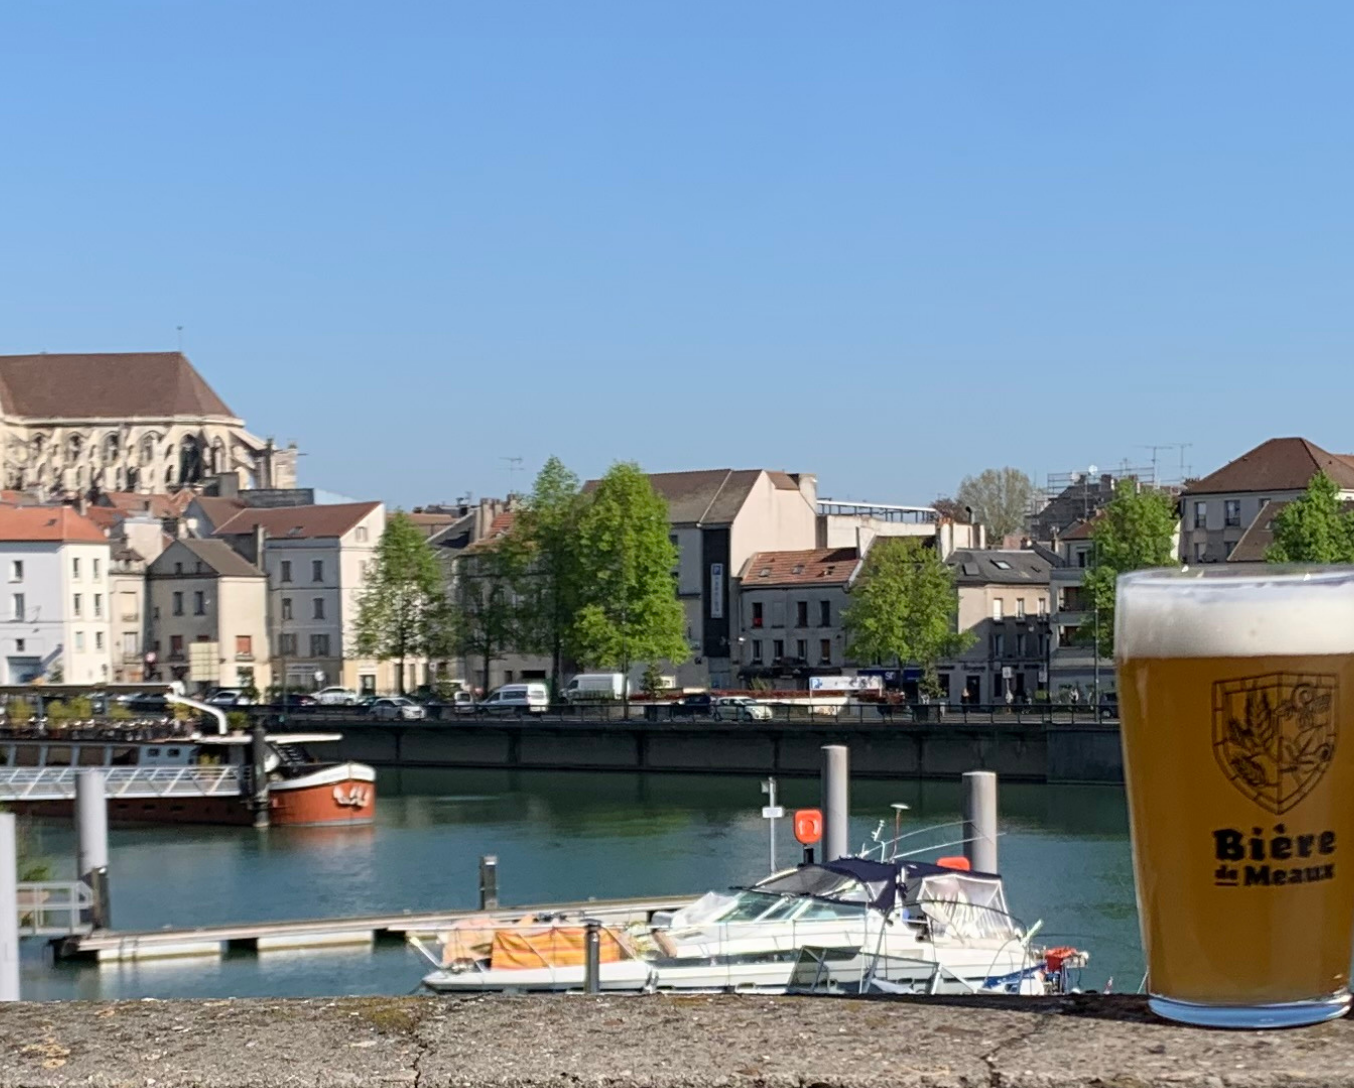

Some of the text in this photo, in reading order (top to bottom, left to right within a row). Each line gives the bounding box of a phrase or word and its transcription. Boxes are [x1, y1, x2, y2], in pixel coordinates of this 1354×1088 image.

[1211, 823, 1336, 861] Bière
[1214, 863, 1335, 886] de Meaux
